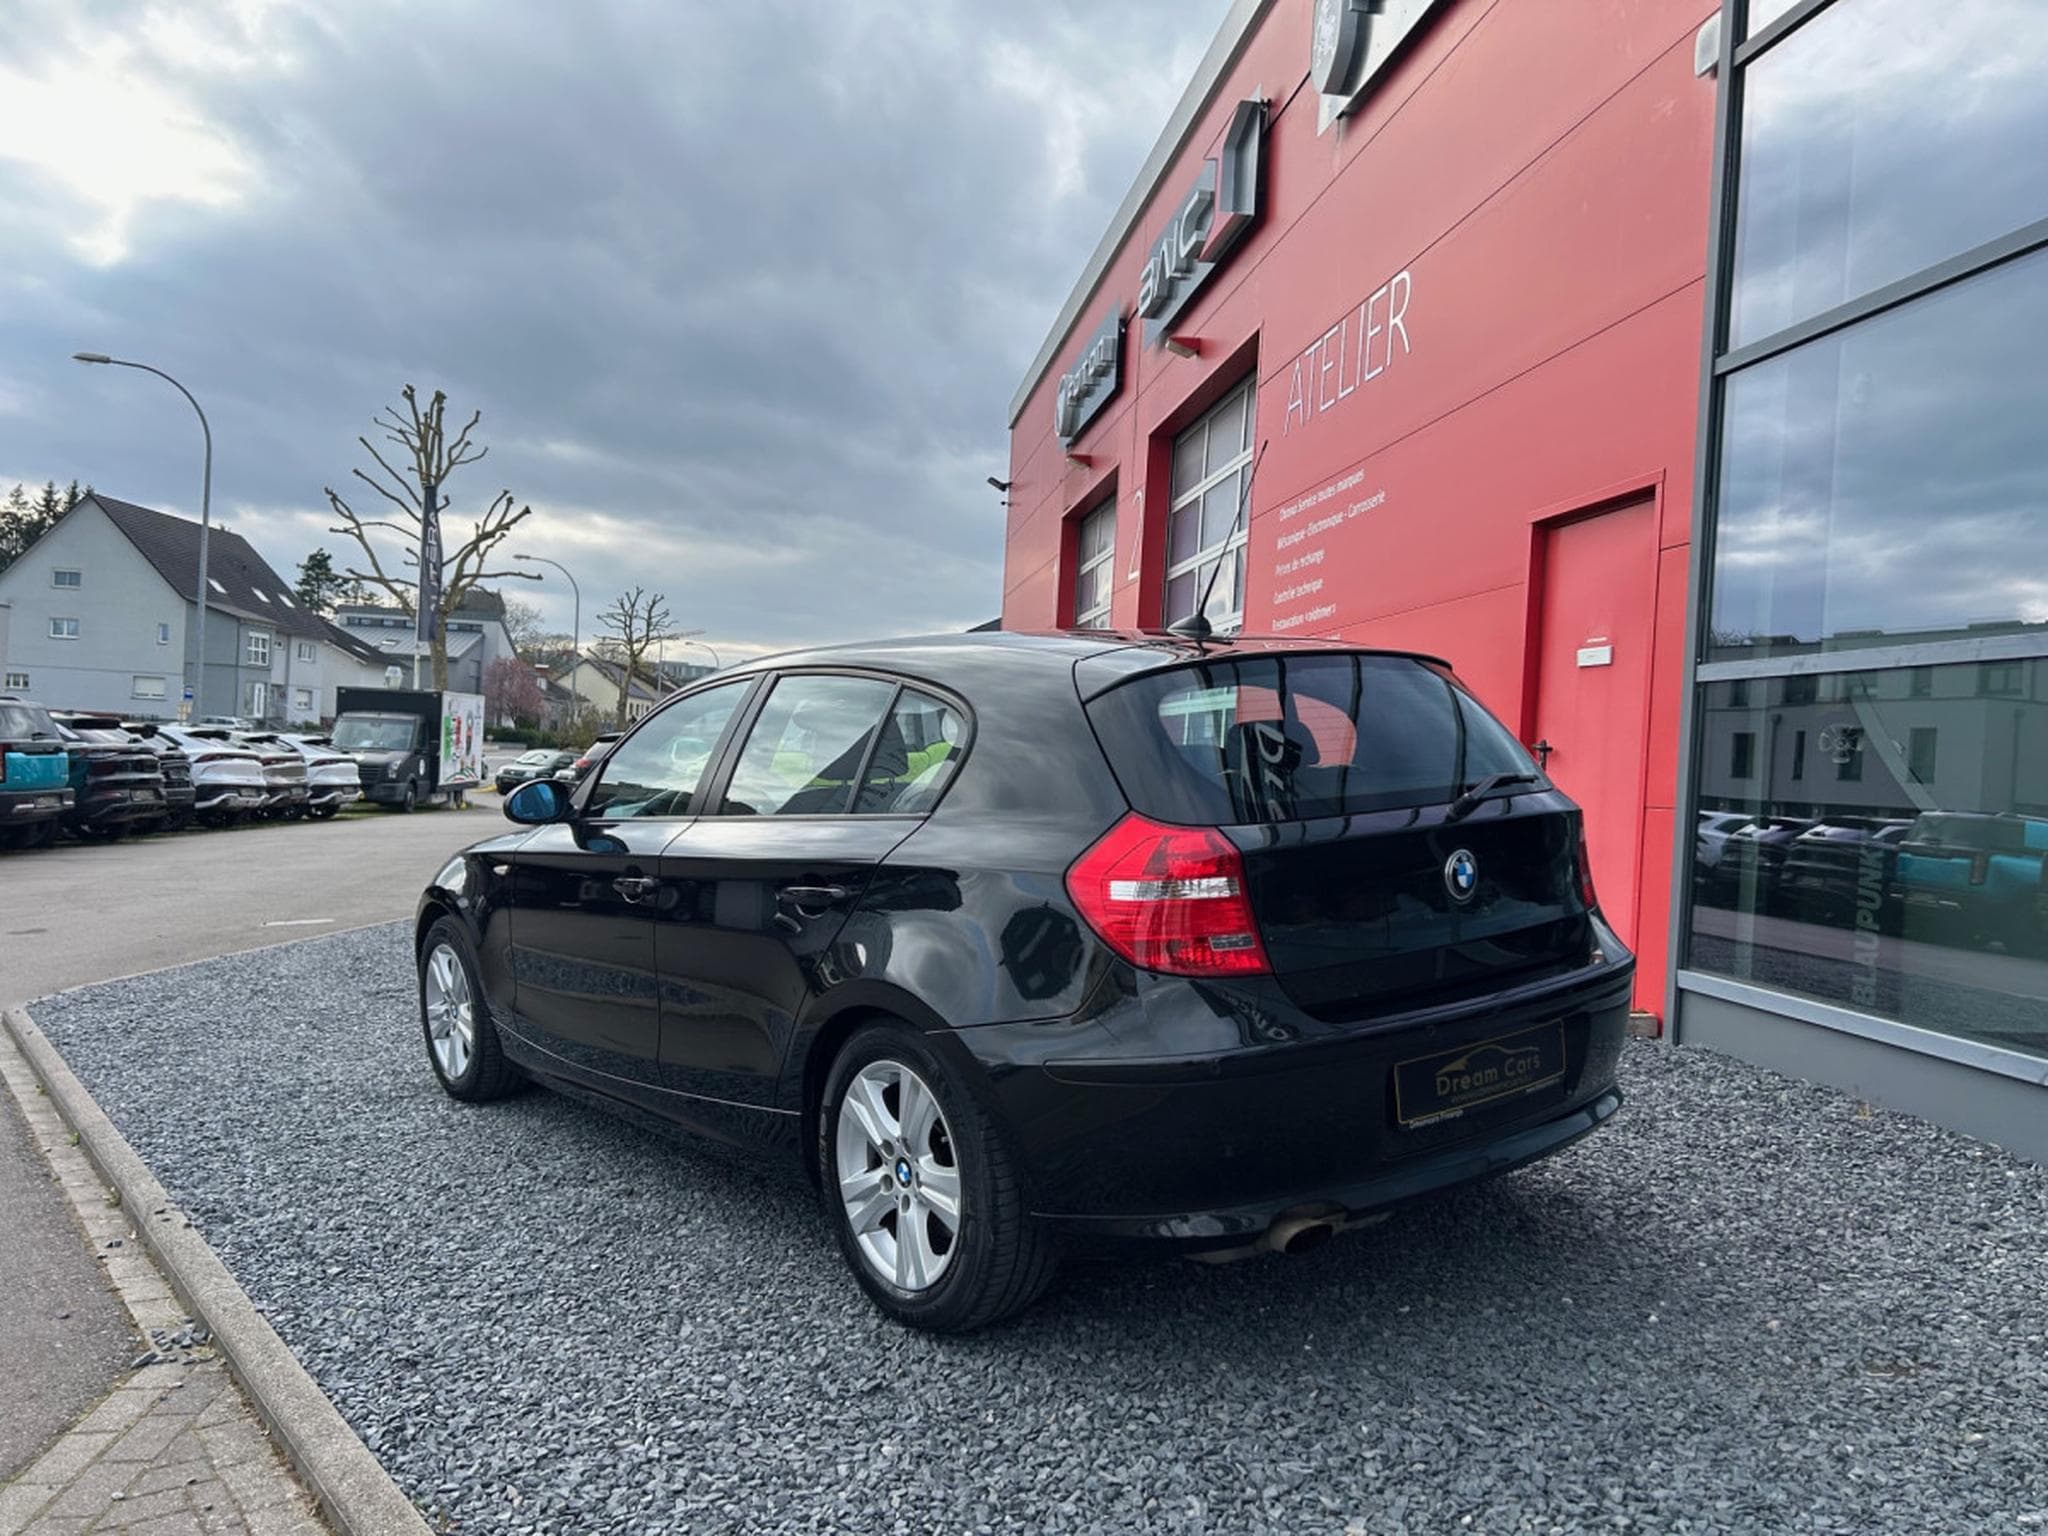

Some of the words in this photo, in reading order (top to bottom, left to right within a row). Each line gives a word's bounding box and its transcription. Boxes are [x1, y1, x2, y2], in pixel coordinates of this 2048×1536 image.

[1283, 270, 1411, 437] ATELIER
[1436, 1068, 1498, 1096] Dream
[1504, 1054, 1541, 1077] Cars
